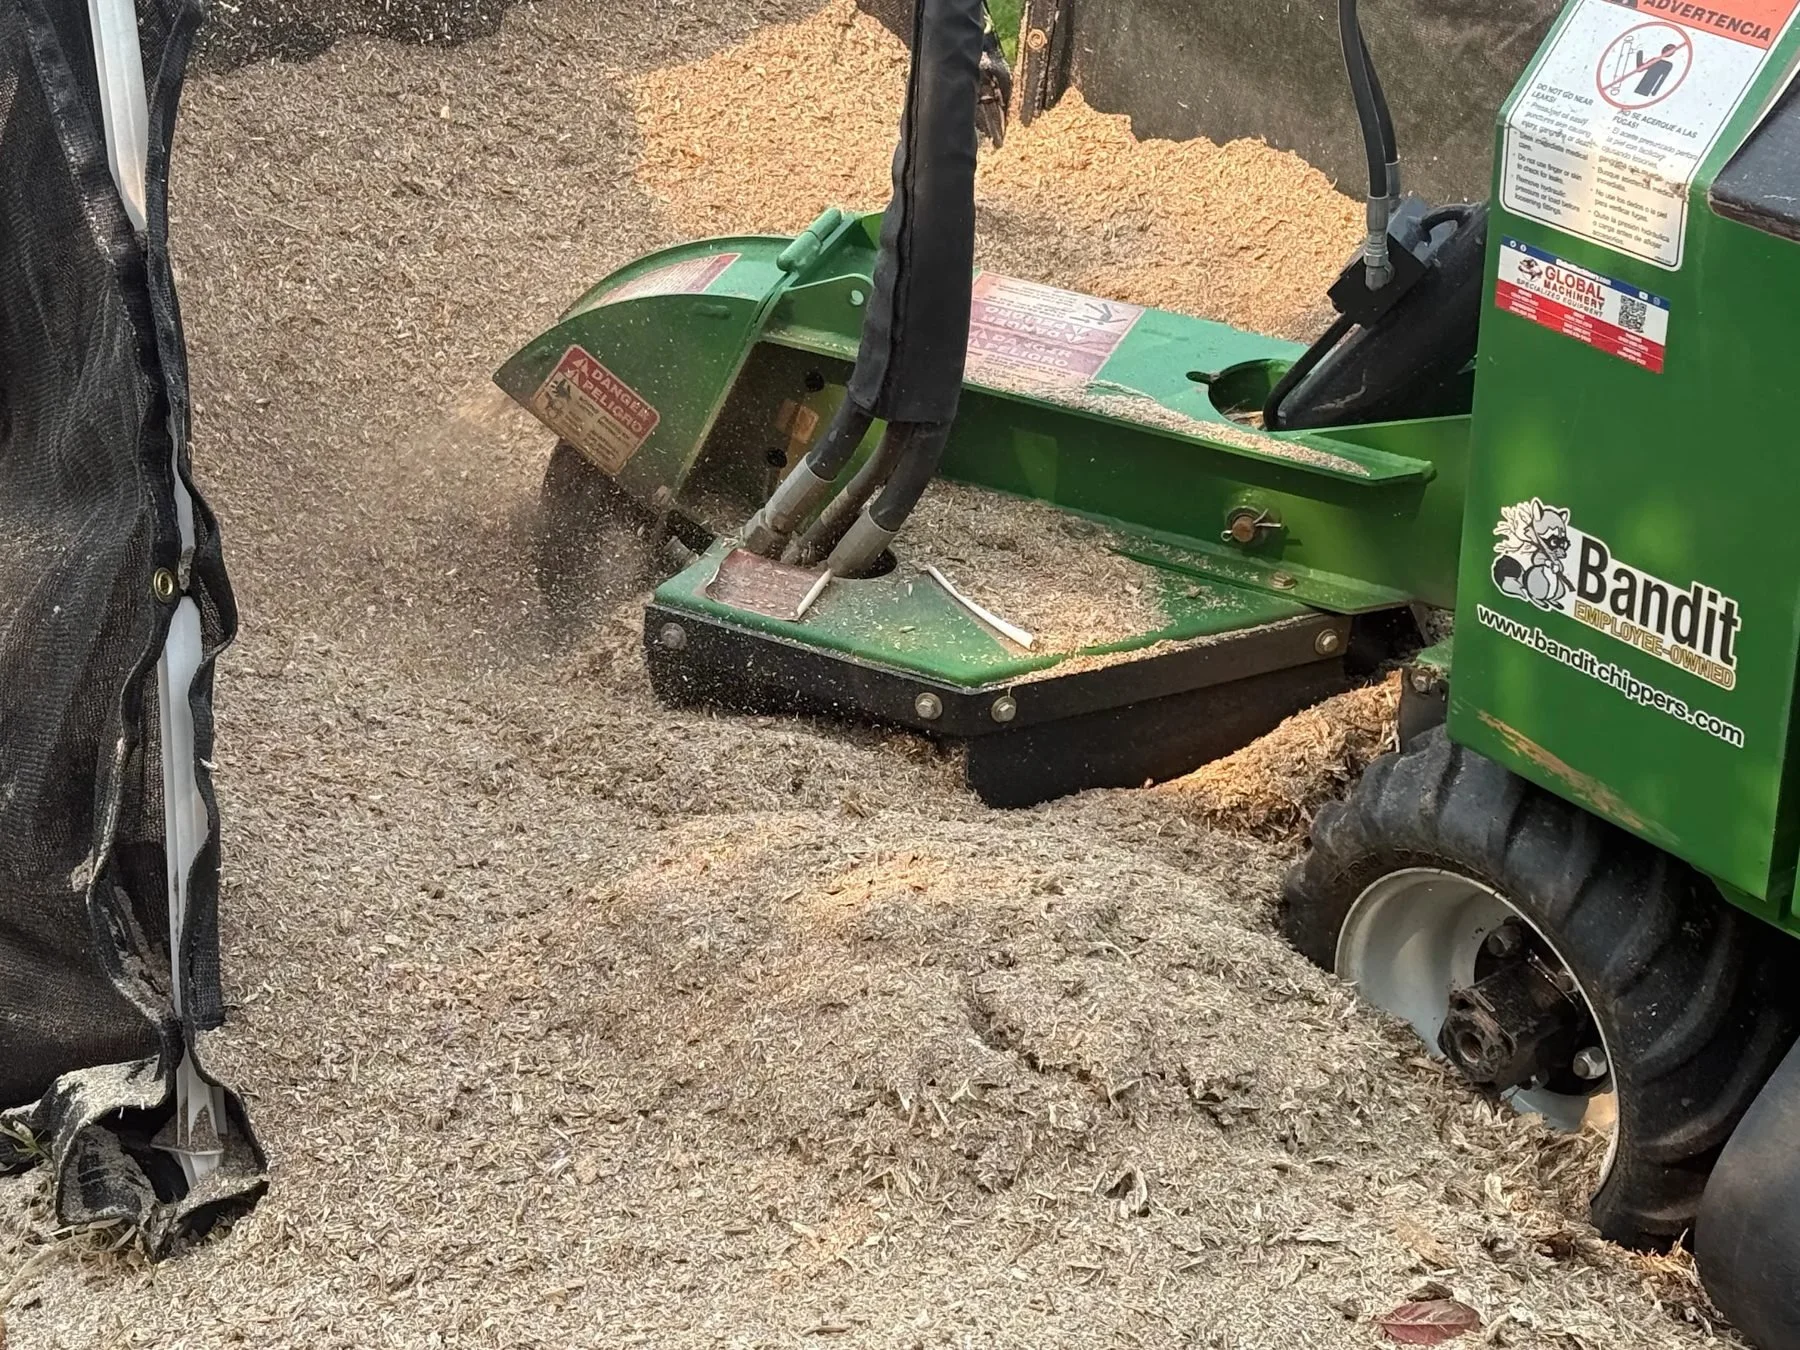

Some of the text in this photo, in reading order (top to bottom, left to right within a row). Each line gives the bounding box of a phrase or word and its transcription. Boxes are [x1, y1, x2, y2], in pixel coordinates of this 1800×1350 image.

[1643, 0, 1771, 41] ADVERTENCIA
[1536, 83, 1594, 106] DO NOT GO NEAR
[1632, 112, 1642, 120] SE
[1682, 129, 1698, 138] LAS
[1518, 153, 1526, 161] Do
[1548, 164, 1563, 173] finger
[1596, 189, 1604, 197] No
[1516, 278, 1561, 301] SPECIALIZED
[1562, 295, 1604, 317] EQUIPMENT
[1543, 280, 1605, 310] MACHINERY
[1545, 265, 1605, 300] GLOBAL
[583, 380, 642, 433] PELIGRO
[592, 369, 650, 421] DANGER
[1576, 535, 1738, 666] Bandit
[1573, 602, 1734, 689] EMPLOYEE-OWNED
[1477, 605, 1744, 748] www.banditchippers.com
